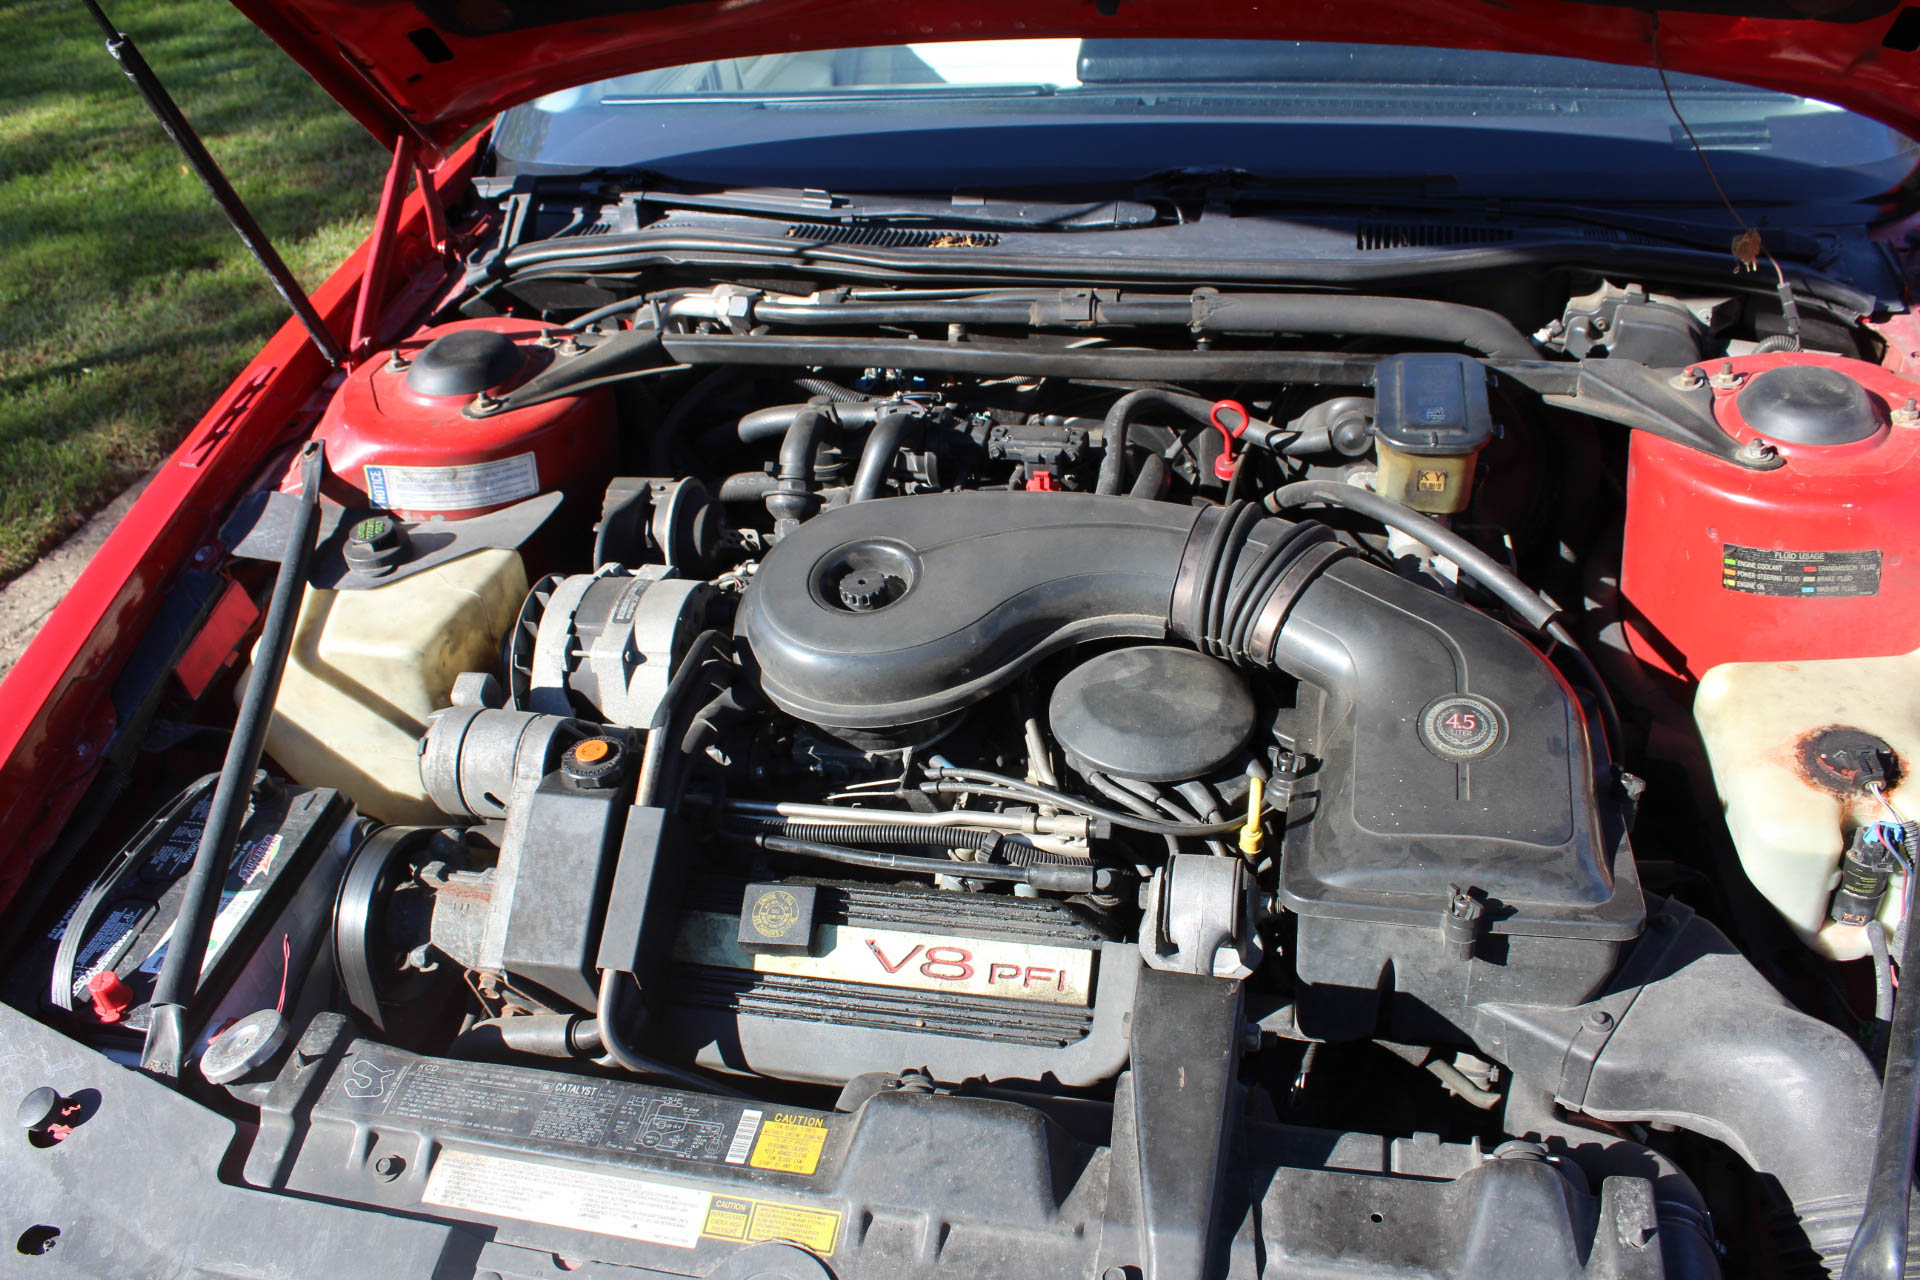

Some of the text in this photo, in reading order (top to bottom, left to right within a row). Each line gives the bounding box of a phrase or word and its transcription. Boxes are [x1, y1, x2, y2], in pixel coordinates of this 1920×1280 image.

[370, 470, 387, 503] NOTICE
[1774, 551, 1797, 560] FLUID
[1799, 552, 1826, 560] USAGE
[1736, 560, 1783, 571] ENGINE COOLANT
[1736, 570, 1756, 579] POWER
[1757, 573, 1783, 582] STEERING
[1736, 580, 1756, 589] ENGINE
[1445, 714, 1478, 730] 4.5
[865, 939, 1067, 992] V8 PFI
[416, 1063, 440, 1073] KCD
[554, 1082, 598, 1097] CATALYST
[774, 1113, 824, 1128] CAUTION
[715, 1199, 746, 1212] CAUTION
